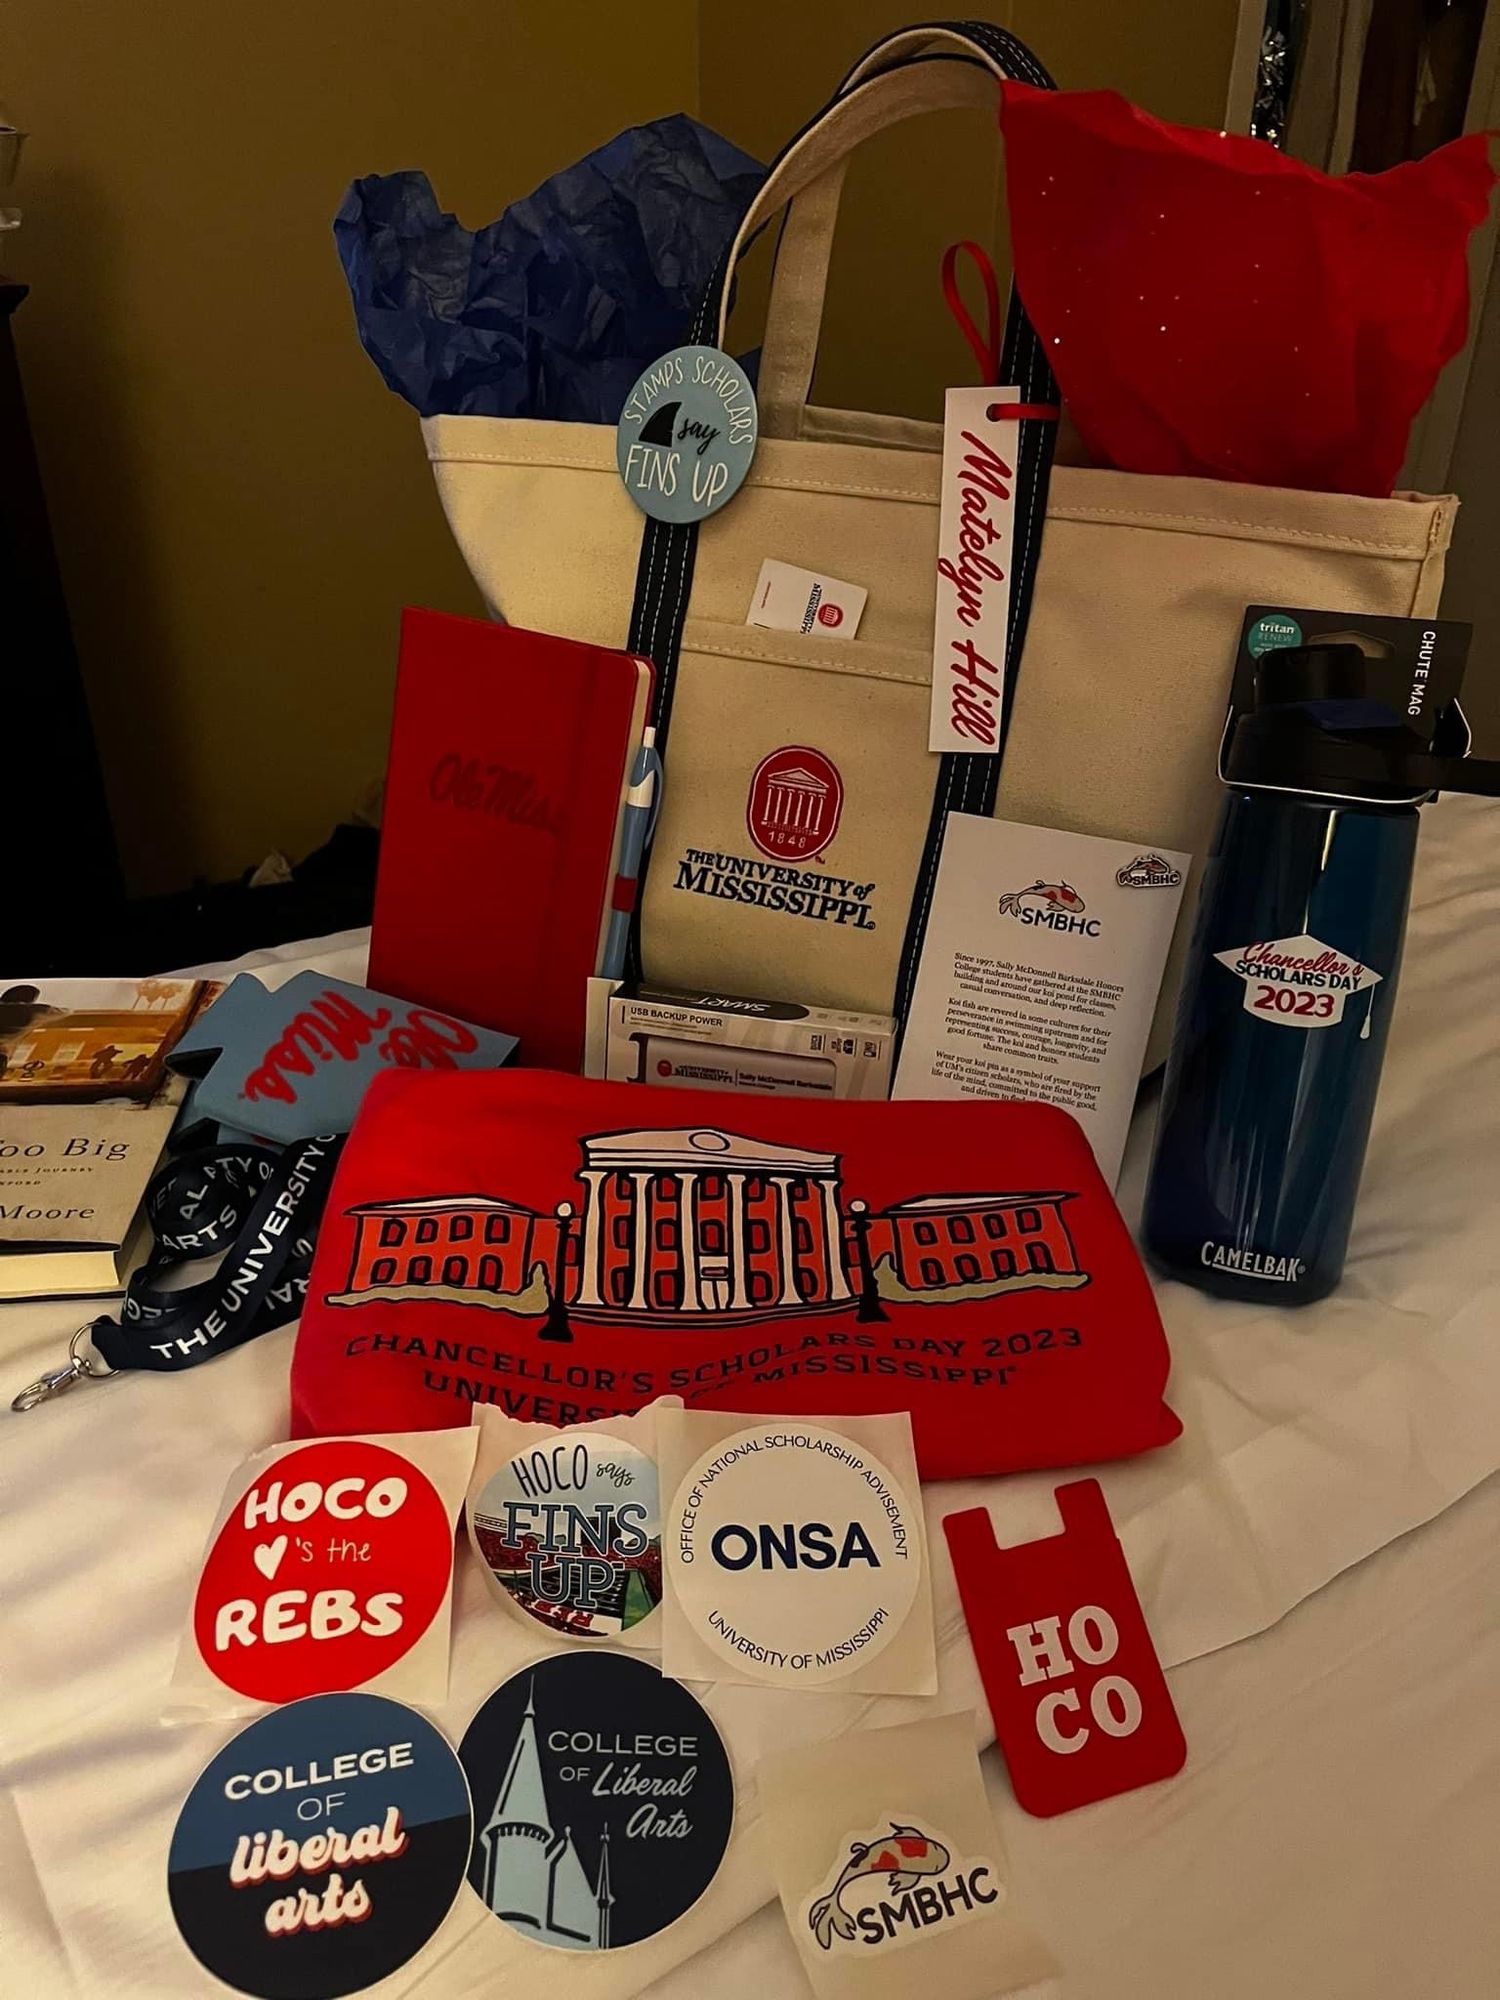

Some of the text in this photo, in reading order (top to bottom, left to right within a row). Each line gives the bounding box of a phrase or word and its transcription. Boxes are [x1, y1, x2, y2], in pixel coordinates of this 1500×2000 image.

[624, 356, 753, 444] STAMPS SCHOLARS
[677, 418, 721, 455] say
[625, 444, 728, 507] FINS UP
[936, 430, 1013, 746] Matelyn Hill
[1260, 622, 1294, 634] tritan
[1408, 631, 1436, 715] CHUTE MAG
[769, 831, 806, 849] 1848
[686, 849, 714, 866] THE
[714, 853, 855, 897] UNIVERSITY
[853, 883, 875, 900] of
[1133, 873, 1178, 886] SMBHC
[673, 860, 875, 930] MISSISSIPPI
[1021, 907, 1101, 937] SMBHC
[954, 970, 983, 983] building
[1000, 982, 1027, 991] around
[1043, 989, 1054, 997] koi
[1056, 992, 1075, 1001] pond
[1077, 996, 1088, 1004] for
[955, 952, 1124, 992] Since Sally McDonnell Barksdale Honors
[955, 962, 1121, 1001] College students have gathered the SMBHC
[1235, 960, 1361, 990] SCHOLARS DAY
[631, 1007, 648, 1016] USB
[651, 1010, 687, 1021] BACKUP
[690, 1016, 722, 1027] POWER
[692, 997, 771, 1012] SMART
[962, 1000, 976, 1009] fish
[1028, 1015, 1048, 1024] some
[1049, 1019, 1079, 1030] cultures
[1093, 1028, 1112, 1037] their
[1050, 1000, 1067, 1010] deep
[1254, 985, 1335, 1017] 2023
[998, 1036, 1011, 1044] The
[1025, 1043, 1040, 1051] and
[1096, 1037, 1108, 1046] for
[936, 1050, 955, 1060] Wear
[956, 1056, 973, 1064] your
[1044, 1074, 1053, 1082] of
[953, 1073, 965, 1081] the
[1039, 1092, 1050, 1100] the
[961, 1085, 975, 1093] and
[1024, 1080, 1040, 1088] who
[1054, 1085, 1072, 1096] fired
[1074, 1089, 1082, 1098] by
[1084, 1092, 1096, 1100] the
[0, 1138, 131, 1161] oo Big
[0, 1205, 95, 1219] Moore
[162, 1204, 237, 1250] ARTS
[151, 1310, 227, 1359] THE
[222, 1144, 324, 1312] UNIVERSITY
[1201, 1241, 1300, 1281] CAMELBAK
[346, 1333, 654, 1395] CHANCELLOR'S
[670, 1333, 876, 1388] SCHOLARS
[893, 1337, 966, 1358] DAY
[983, 1327, 1083, 1358] 2023
[752, 1354, 1009, 1385] MISSISSIPPI
[512, 1444, 635, 1498] HOCO says
[244, 1477, 408, 1530] HOCO
[680, 1435, 907, 1563] OFFICE OF NATIONAL SCHOLARSHIP ADVISEMENT
[501, 1501, 649, 1558] FINS
[711, 1522, 881, 1571] ONSA
[296, 1536, 372, 1563] 's the
[526, 1552, 616, 1609] UP
[215, 1589, 403, 1652] REBS
[709, 1607, 889, 1669] UNIVERSITY OF MISSISSIPPI
[1006, 1605, 1118, 1687] HO
[1036, 1675, 1142, 1754] CO
[549, 1731, 698, 1757] COLLEGE
[224, 1742, 414, 1800] COLLEGE
[559, 1762, 698, 1797] OF Liberal
[297, 1792, 346, 1821] OF
[626, 1803, 693, 1839] Arts
[229, 1806, 410, 1888] liberal
[265, 1873, 373, 1937] arts
[857, 1867, 998, 1944] SMBHC
